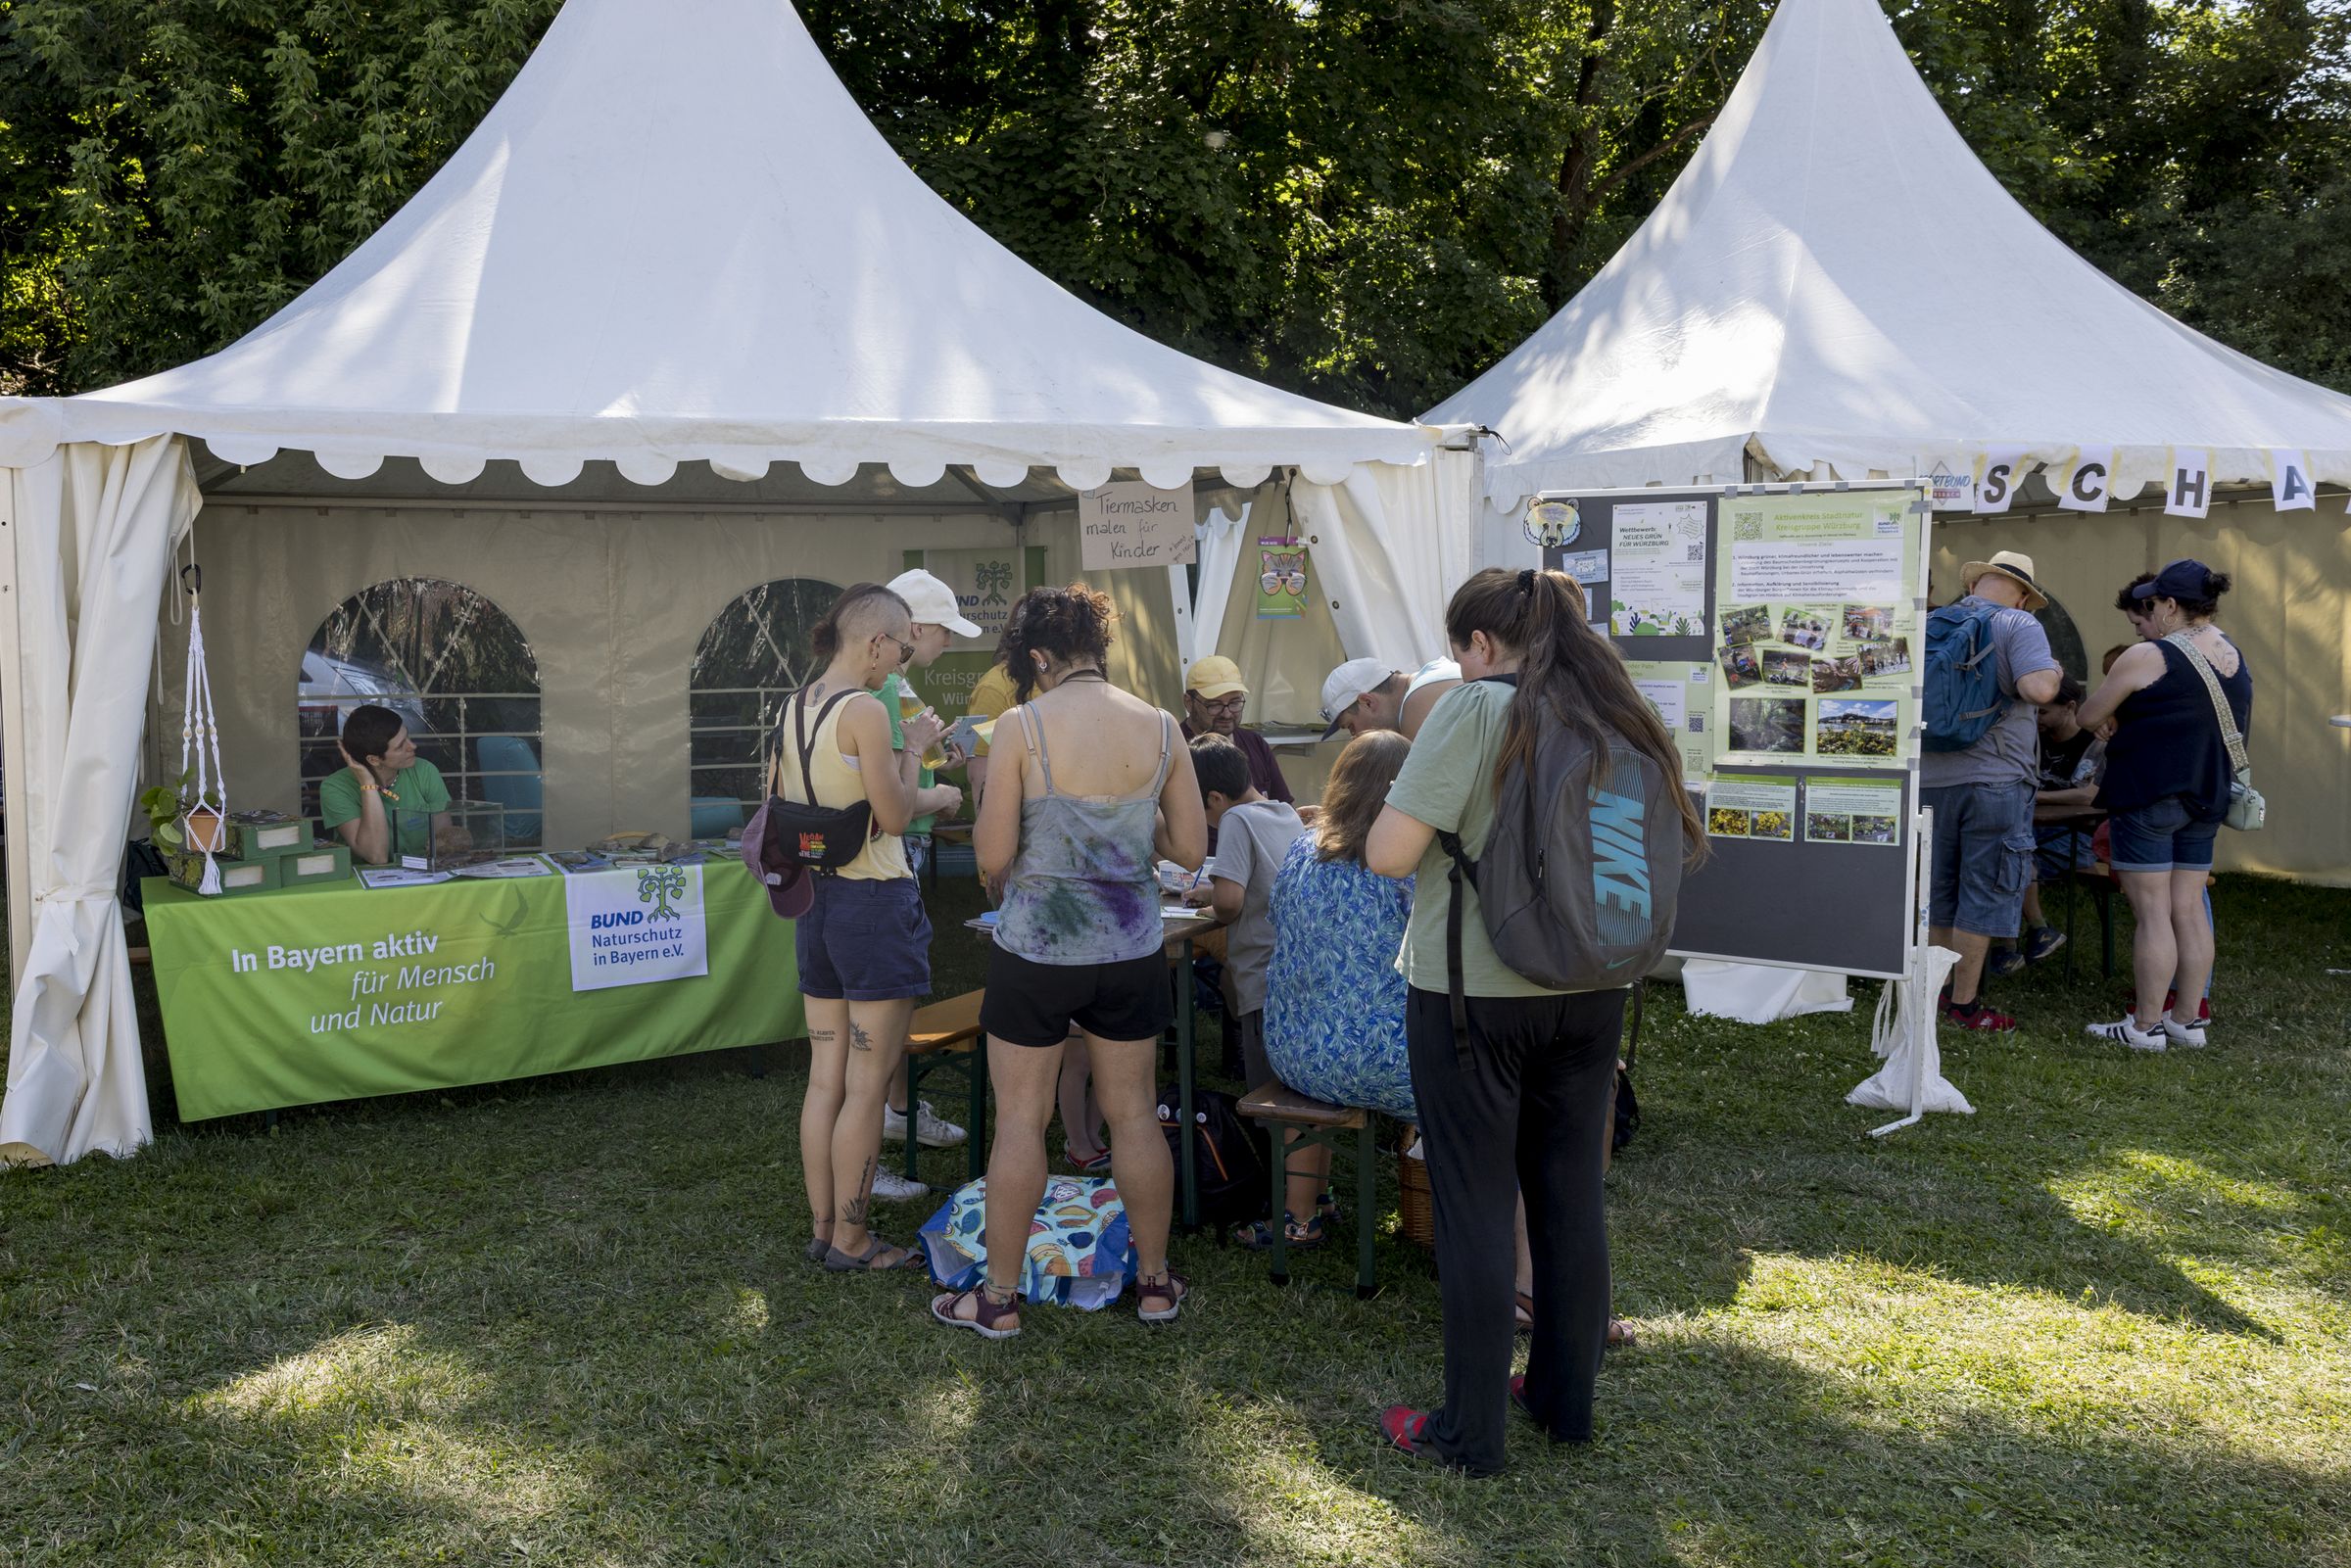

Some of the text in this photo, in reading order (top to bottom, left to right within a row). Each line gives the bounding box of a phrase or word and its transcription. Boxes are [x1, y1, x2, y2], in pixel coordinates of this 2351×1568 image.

[1095, 492, 1178, 515] Tiermasken
[1086, 518, 1159, 541] malen für
[1110, 540, 1161, 559] Kinder
[960, 610, 1008, 622] urschutz
[1588, 778, 1653, 930] NIKE
[591, 910, 644, 929] BUND
[592, 927, 683, 948] Naturschutz
[232, 930, 438, 973] In Bayern aktiv
[594, 943, 684, 966] in Bayern e.V.
[351, 956, 495, 1001] für Mensch
[311, 1001, 444, 1034] und Natur
